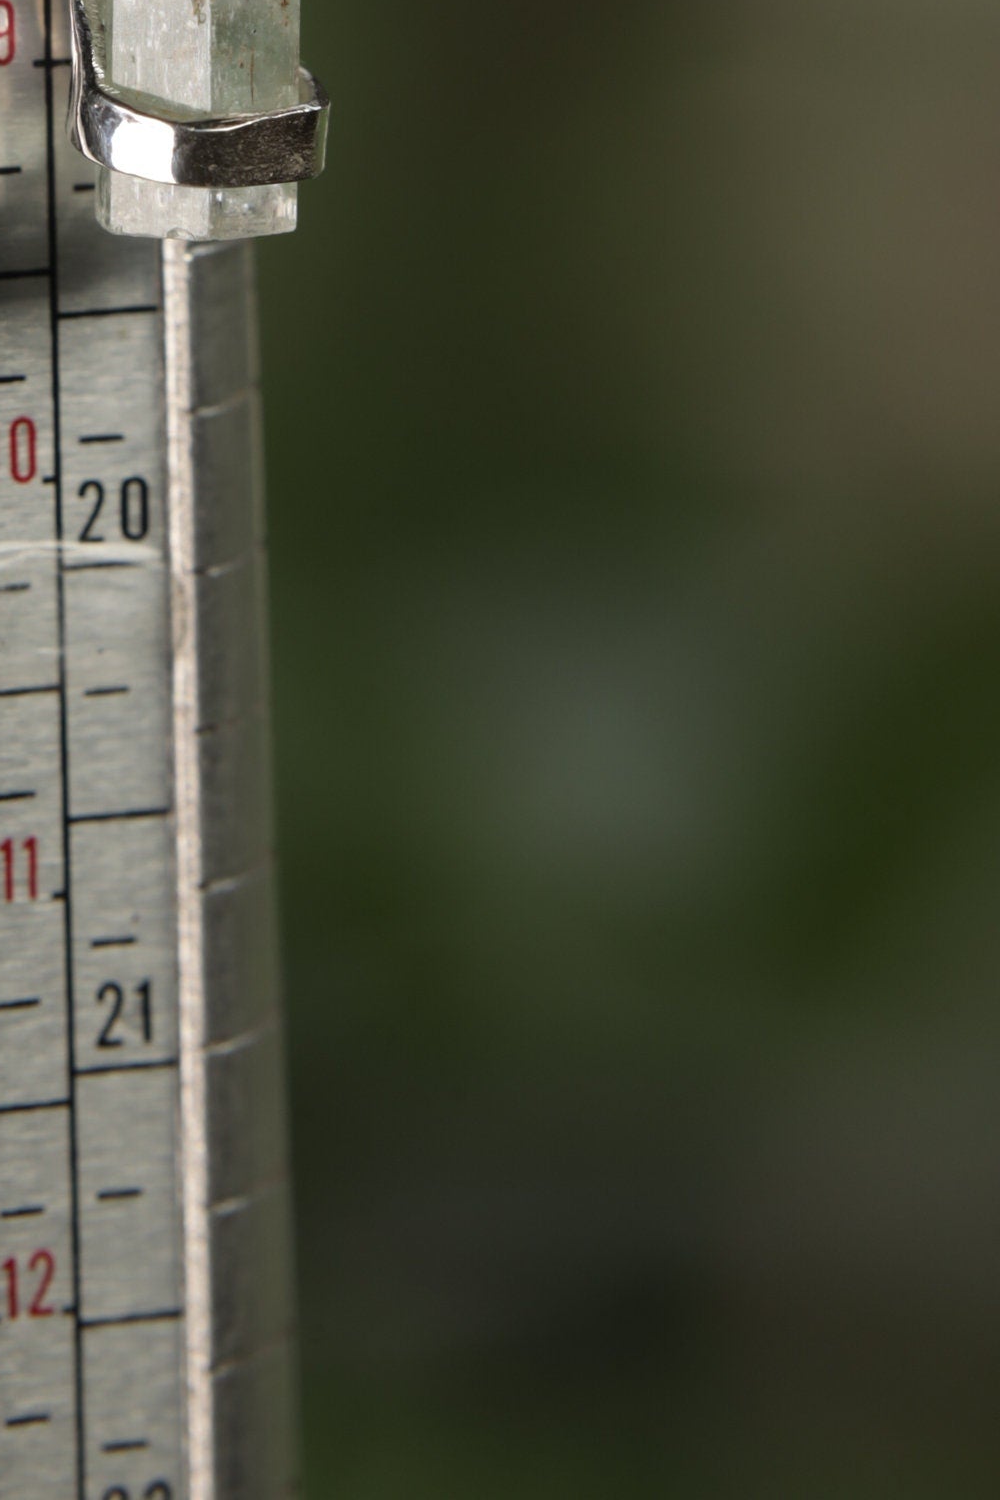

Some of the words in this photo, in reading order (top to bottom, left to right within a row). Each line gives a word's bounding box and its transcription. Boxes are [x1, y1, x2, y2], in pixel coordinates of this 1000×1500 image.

[78, 476, 151, 542] 20
[96, 980, 152, 1049] 21
[2, 1248, 55, 1320] 12
